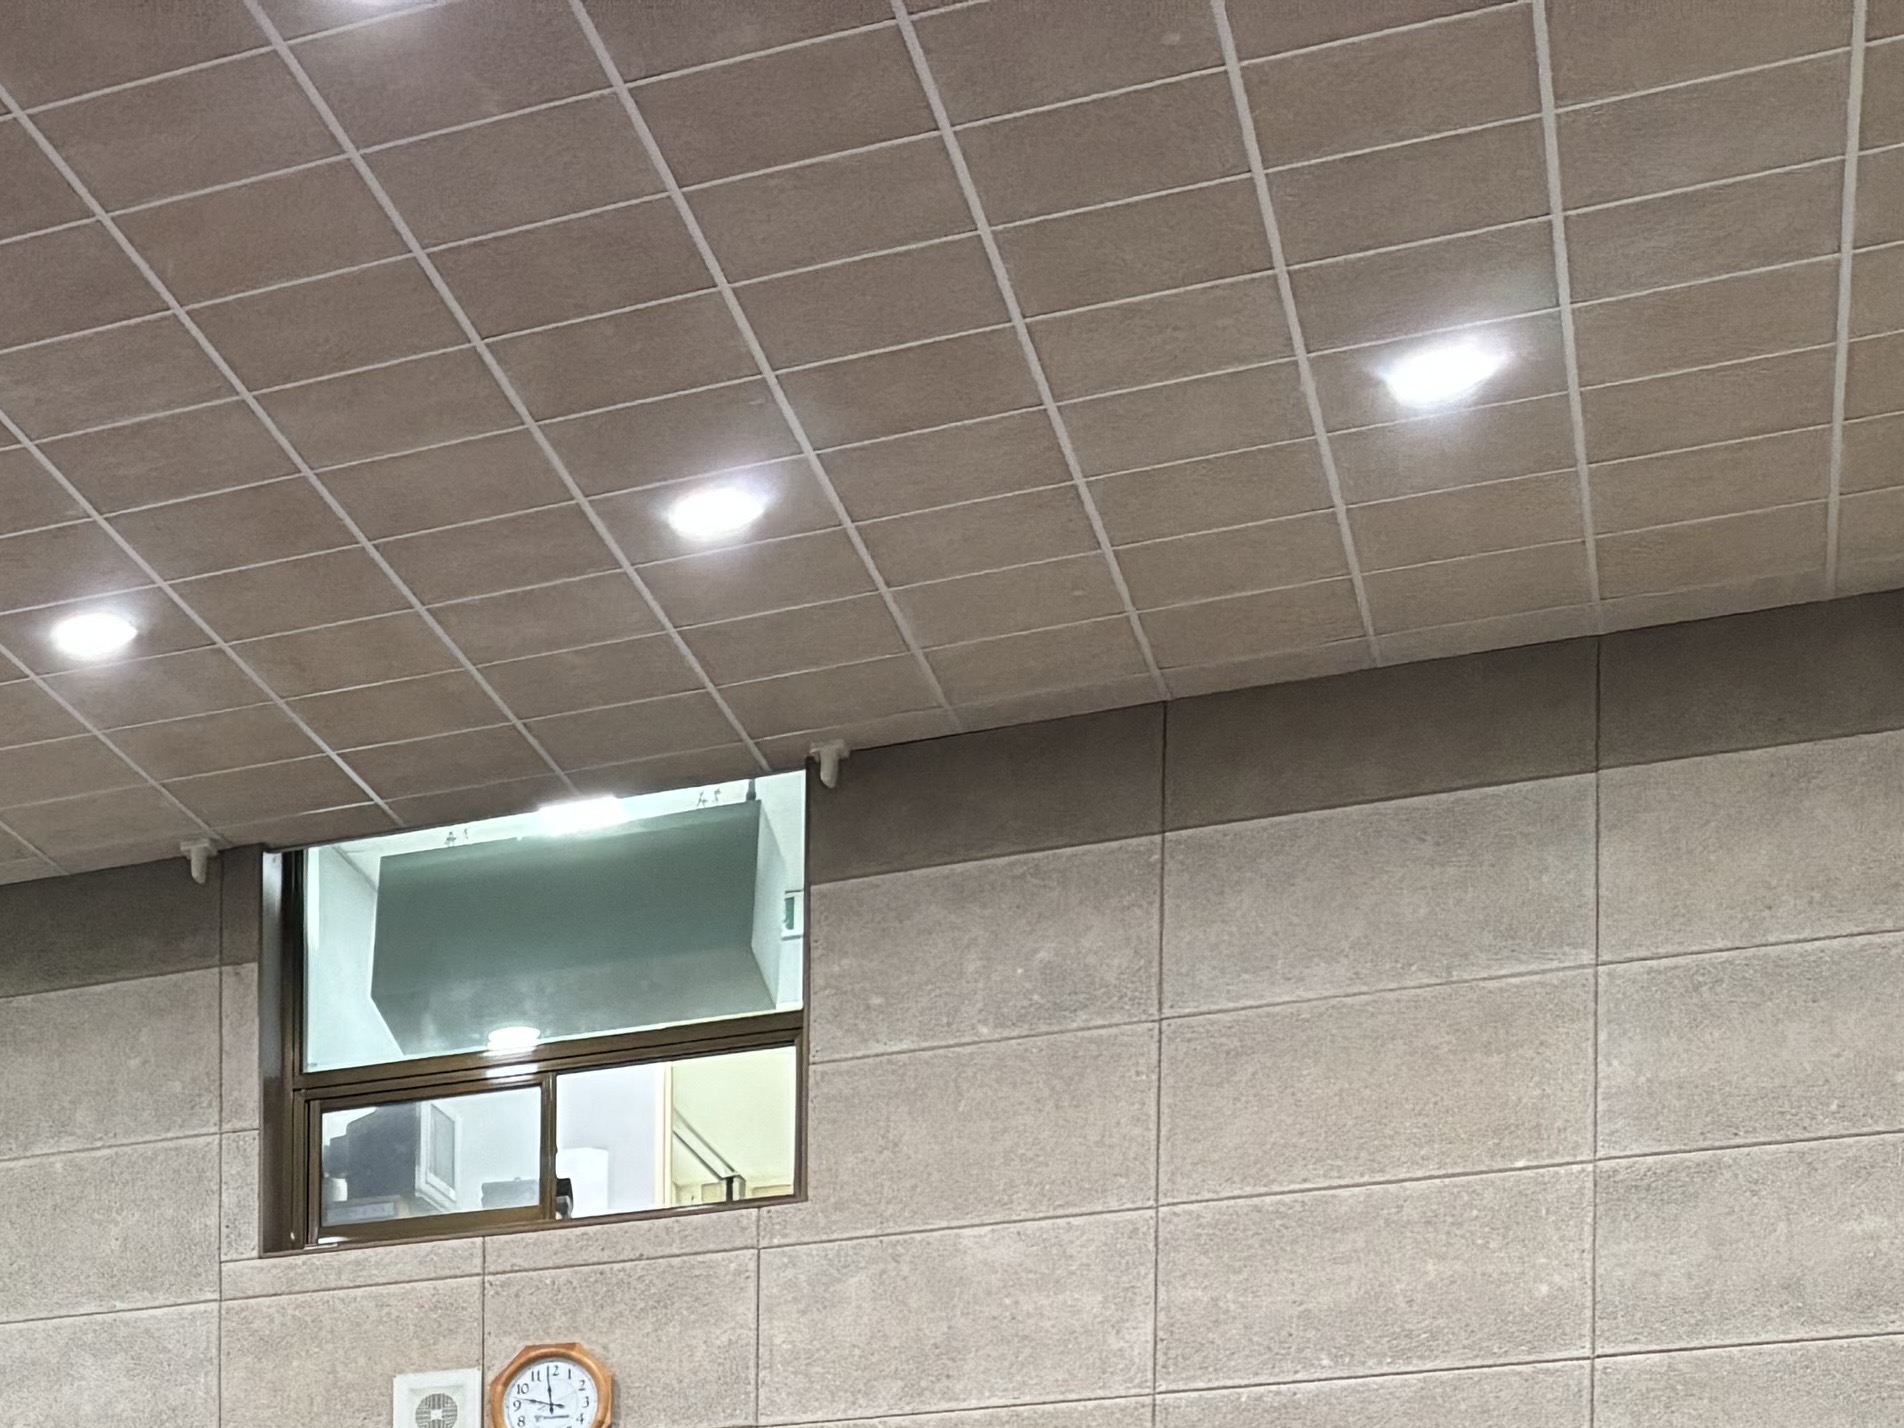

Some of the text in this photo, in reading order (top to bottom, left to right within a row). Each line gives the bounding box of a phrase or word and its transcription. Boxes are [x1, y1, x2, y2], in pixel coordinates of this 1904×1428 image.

[531, 1370, 541, 1382] 11
[568, 1368, 571, 1380] 1
[517, 1383, 529, 1394] 10
[578, 1380, 586, 1391] 2
[513, 1400, 521, 1412] 9
[583, 1396, 589, 1408] 3
[517, 1416, 525, 1427] 8
[576, 1413, 584, 1425] 4
